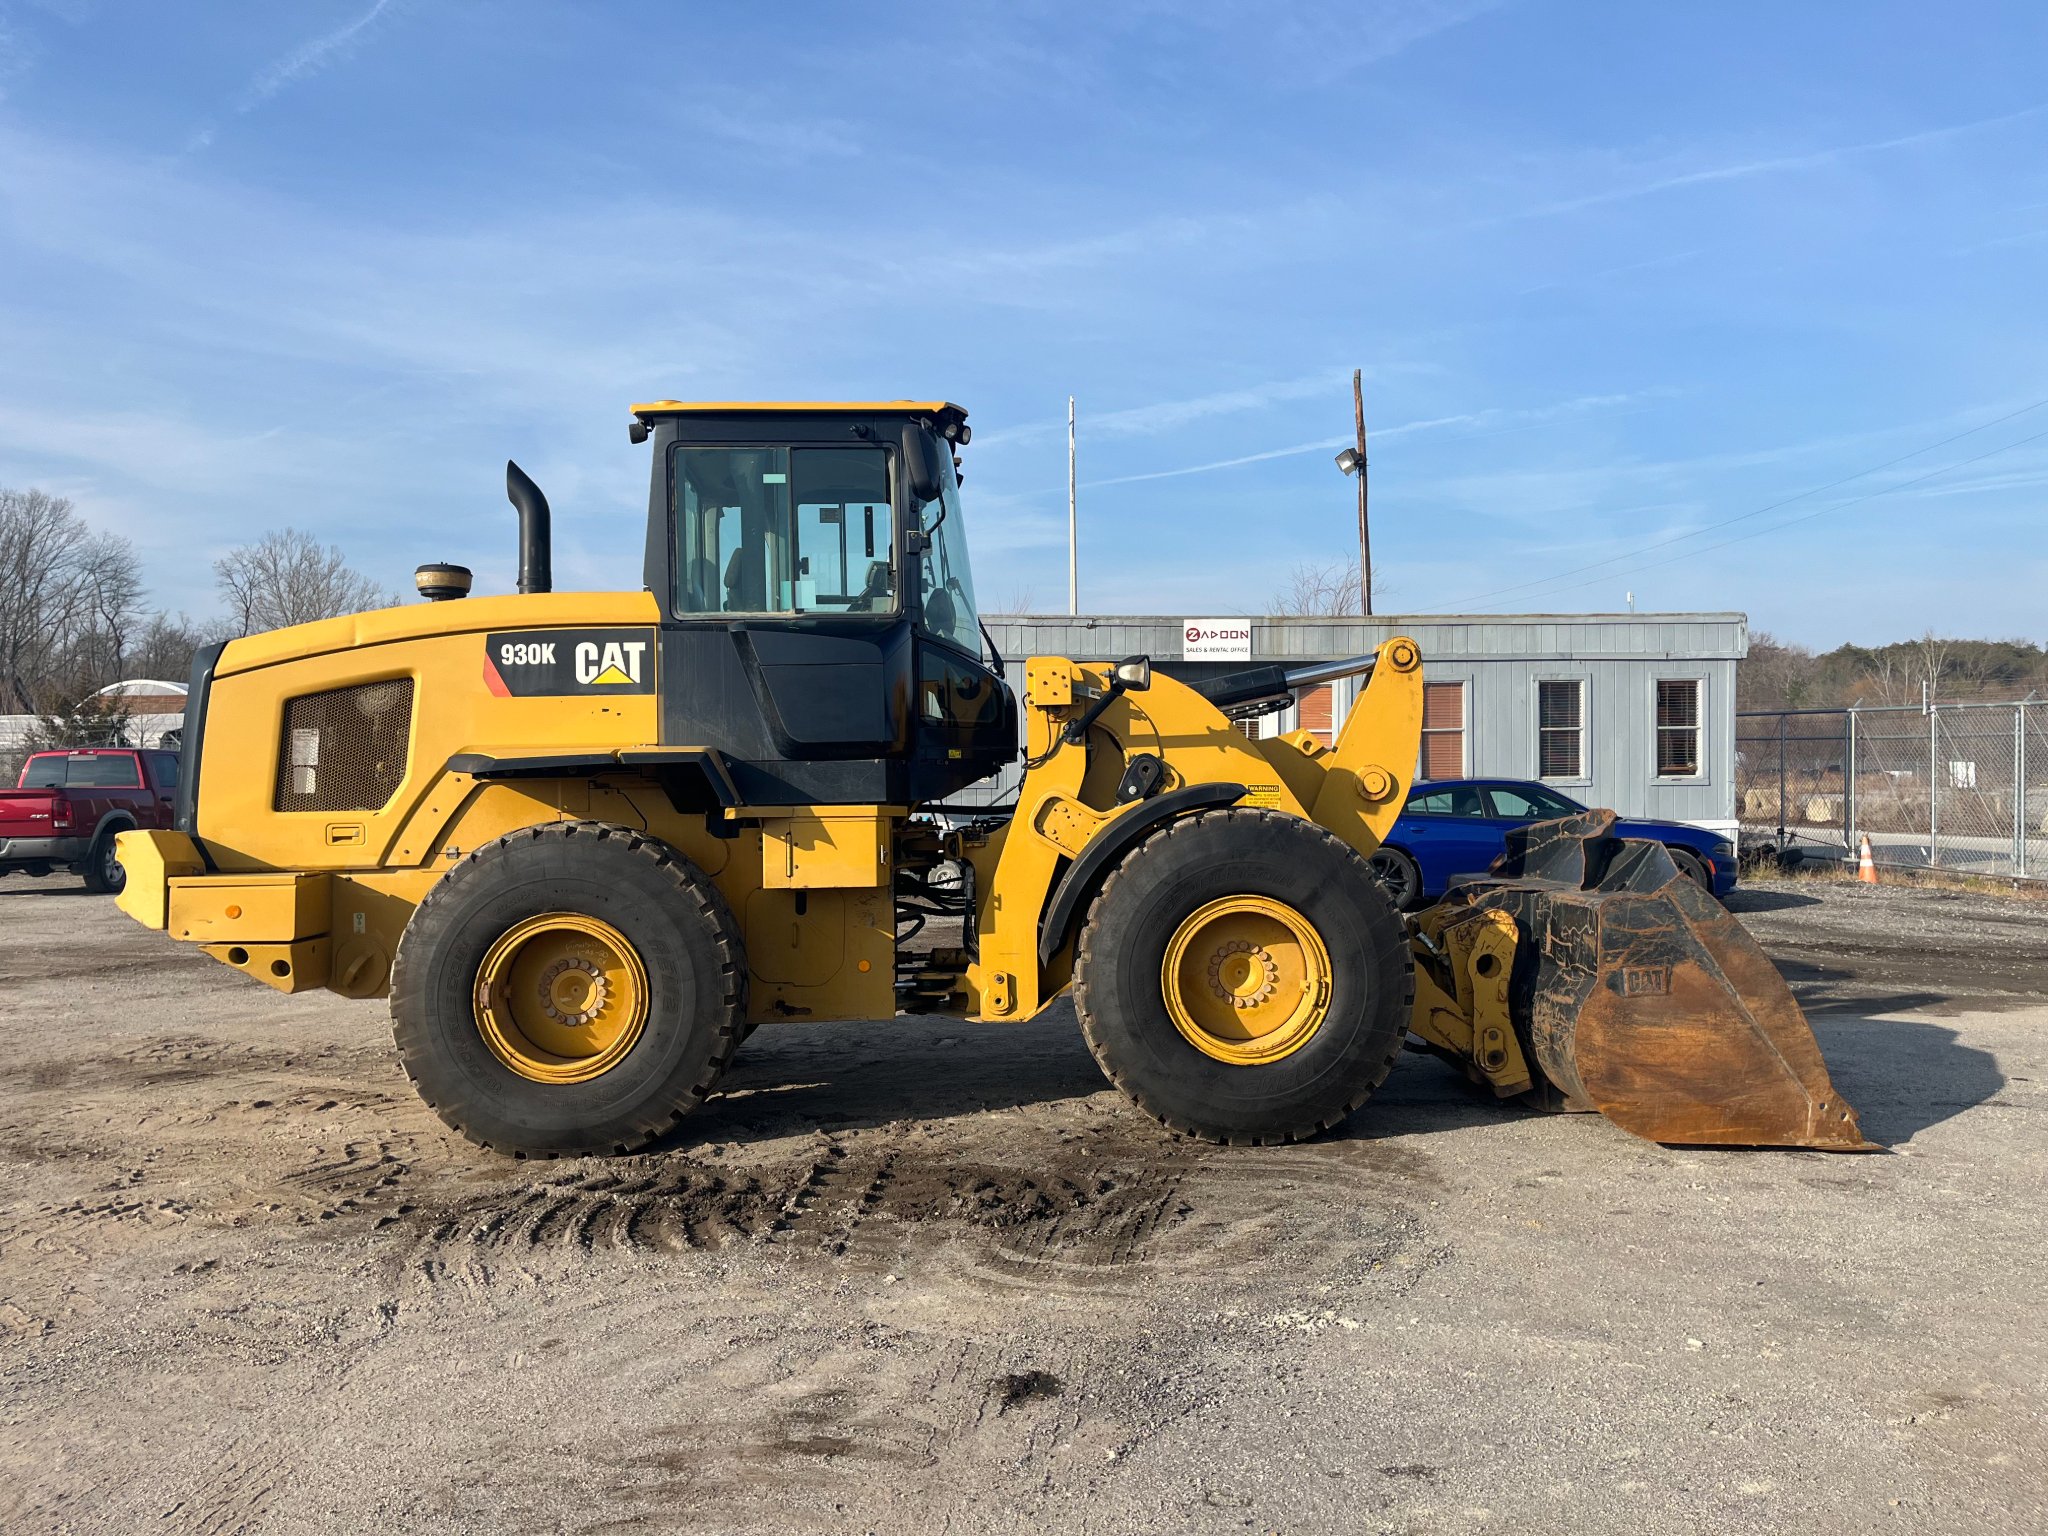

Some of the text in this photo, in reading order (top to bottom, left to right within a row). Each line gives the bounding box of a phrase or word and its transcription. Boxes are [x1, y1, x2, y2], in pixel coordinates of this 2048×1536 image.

[1186, 628, 1249, 642] ZADOON
[501, 642, 646, 684] 930K CAT
[1629, 970, 1663, 993] CAT
